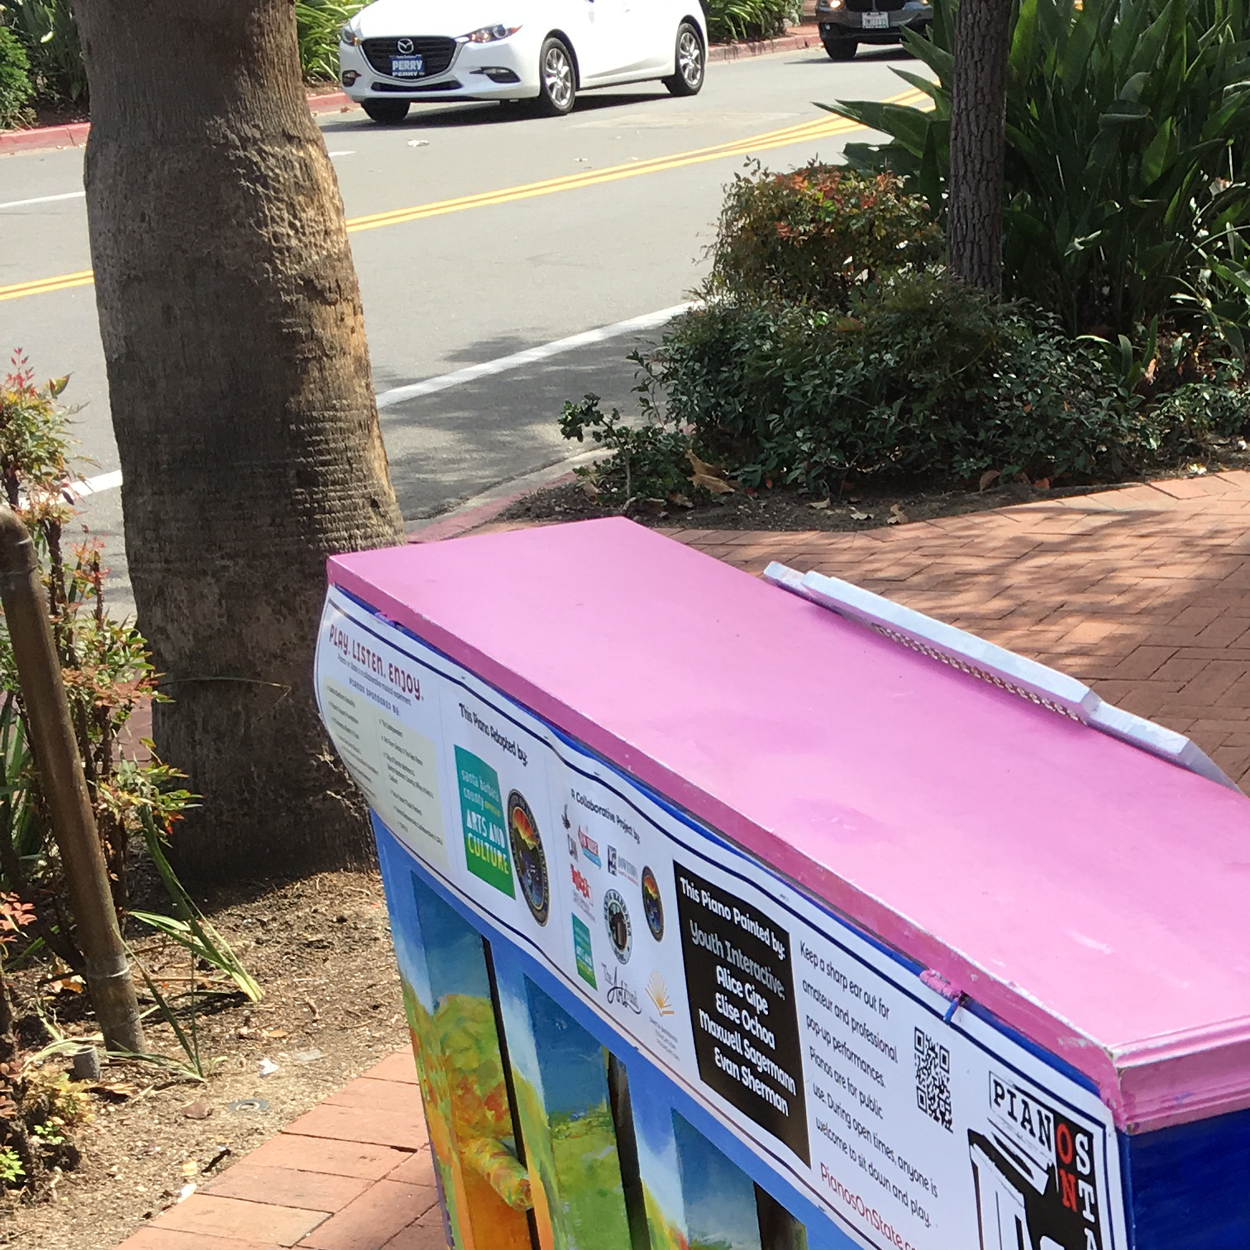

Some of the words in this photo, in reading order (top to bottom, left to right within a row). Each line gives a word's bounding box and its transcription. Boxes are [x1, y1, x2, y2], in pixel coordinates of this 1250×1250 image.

[392, 60, 423, 70] PERRY
[329, 623, 351, 656] PLAY.
[352, 638, 387, 679] LISTEN.
[388, 662, 424, 701] ENJOY.
[459, 702, 473, 724] This
[472, 711, 489, 736] Piano
[490, 725, 516, 756] Adopted
[461, 769, 479, 788] santa
[463, 787, 484, 811] county
[576, 792, 615, 823] Collaborative
[616, 814, 633, 837] Project
[466, 809, 487, 838] ARTS
[489, 822, 505, 849] AND
[468, 832, 509, 875] CULTURE
[680, 877, 700, 903] This
[701, 889, 731, 921] Piano
[733, 907, 770, 947] Painted
[771, 931, 785, 961] by:
[690, 919, 724, 958] Youth
[725, 940, 785, 1000] Interactive,
[716, 965, 743, 998] Alice
[744, 982, 769, 1016] Gipe
[799, 940, 818, 969] Keep
[820, 958, 825, 972] a
[826, 961, 848, 992] sharp
[849, 980, 862, 1000] ear
[863, 991, 877, 1012] out
[878, 997, 889, 1020] for
[698, 1008, 743, 1056] Maxwell
[743, 1038, 797, 1097] Sagermann
[715, 992, 741, 1024] Elise
[741, 1009, 776, 1050] Ochoa
[802, 979, 833, 1013] amateur
[834, 1004, 850, 1026] and
[851, 1017, 898, 1064] professional
[806, 1014, 831, 1047] pop-up
[832, 1036, 886, 1089] performances.
[714, 1046, 741, 1082] Evan
[741, 1065, 789, 1117] Sherman
[809, 1045, 833, 1078] Pianos
[833, 1070, 847, 1089] are
[847, 1077, 858, 1099] for
[859, 1090, 883, 1120] public
[813, 1083, 826, 1103] use.
[827, 1092, 851, 1129] During
[852, 1118, 872, 1145] open
[873, 1132, 897, 1166] times,
[898, 1155, 929, 1191] anyone
[930, 1178, 939, 1199] is
[993, 1078, 1092, 1176] PIANOS
[816, 1117, 848, 1155] welcome
[848, 1143, 857, 1162] to
[858, 1152, 867, 1173] sit
[868, 1161, 891, 1193] down
[892, 1182, 909, 1207] and
[910, 1199, 932, 1228] play.
